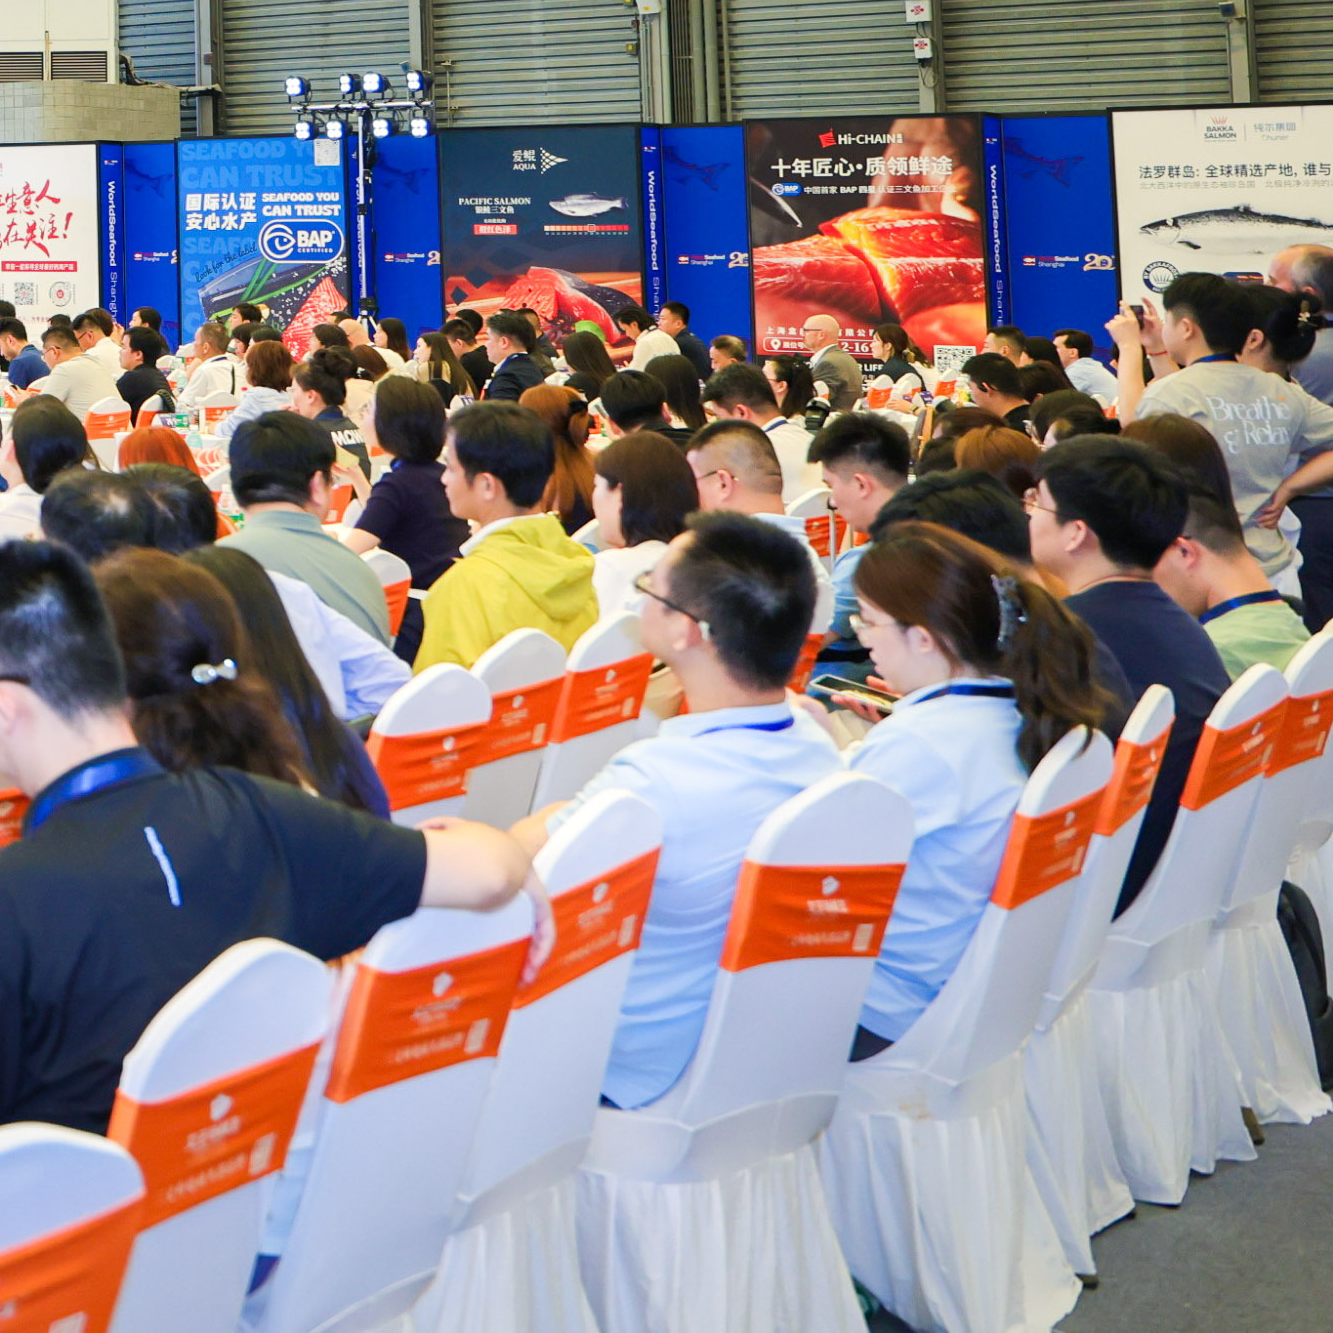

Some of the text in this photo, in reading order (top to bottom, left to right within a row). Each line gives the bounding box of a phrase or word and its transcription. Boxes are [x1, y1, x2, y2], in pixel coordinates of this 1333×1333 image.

[838, 133, 897, 145] Hi-CHAIN
[183, 164, 338, 188] CAN TRUST
[513, 163, 536, 171] AQUA
[771, 155, 953, 178] 十年匠心·质领鲜途
[185, 192, 257, 212] 国际认证
[262, 192, 340, 203] SEAFOOD YOU
[459, 197, 531, 206] PACIFIC SALMON
[262, 204, 341, 216] CAN TRUST
[989, 165, 1001, 273] WorldSeafood
[108, 181, 117, 266] WorldSeafood
[185, 212, 257, 231] 安心水产
[648, 171, 659, 270] WorldSeafood
[297, 230, 333, 248] BAP
[1206, 396, 1292, 422] Breathe
